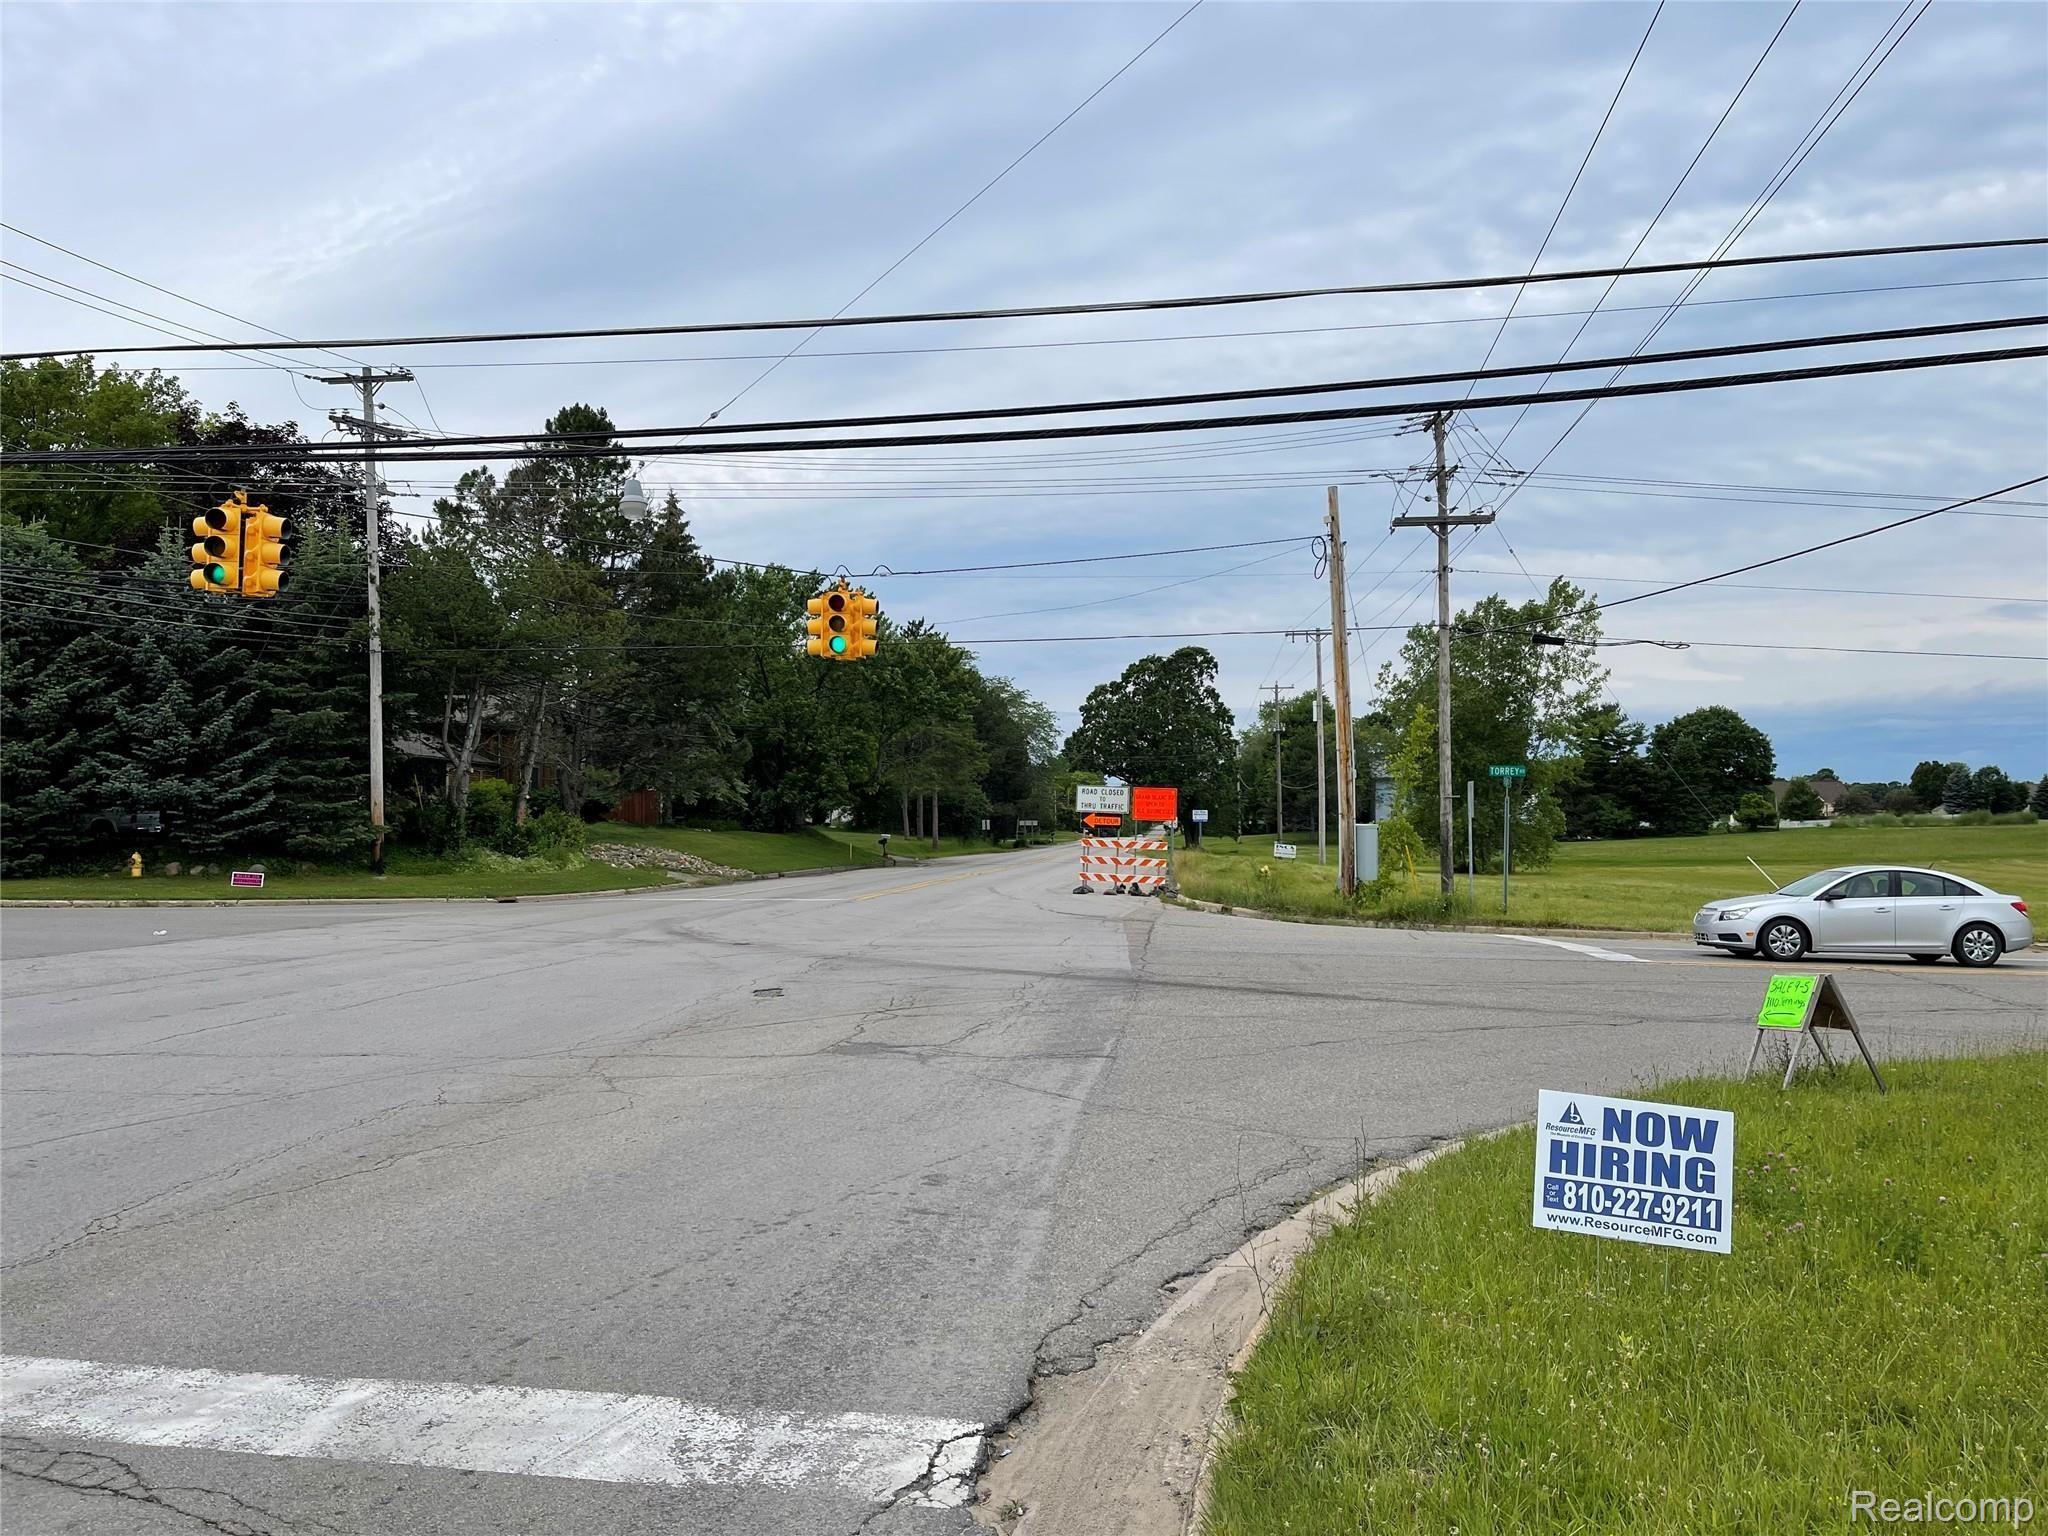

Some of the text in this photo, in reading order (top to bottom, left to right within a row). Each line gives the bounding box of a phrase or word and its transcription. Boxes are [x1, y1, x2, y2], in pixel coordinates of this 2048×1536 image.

[1490, 767, 1519, 775] TORREY
[1101, 788, 1124, 796] CLOSED
[1100, 803, 1124, 811] TRAFFIC
[1545, 1122, 1597, 1136] ResourceMFG
[1602, 1107, 1719, 1154] NOW
[1549, 1139, 1716, 1195] HIRING
[1546, 1183, 1559, 1191] Call
[1545, 1195, 1559, 1203] Text
[1563, 1181, 1717, 1230] 810-227-9211
[1546, 1213, 1717, 1245] www.ResourceMFG.com
